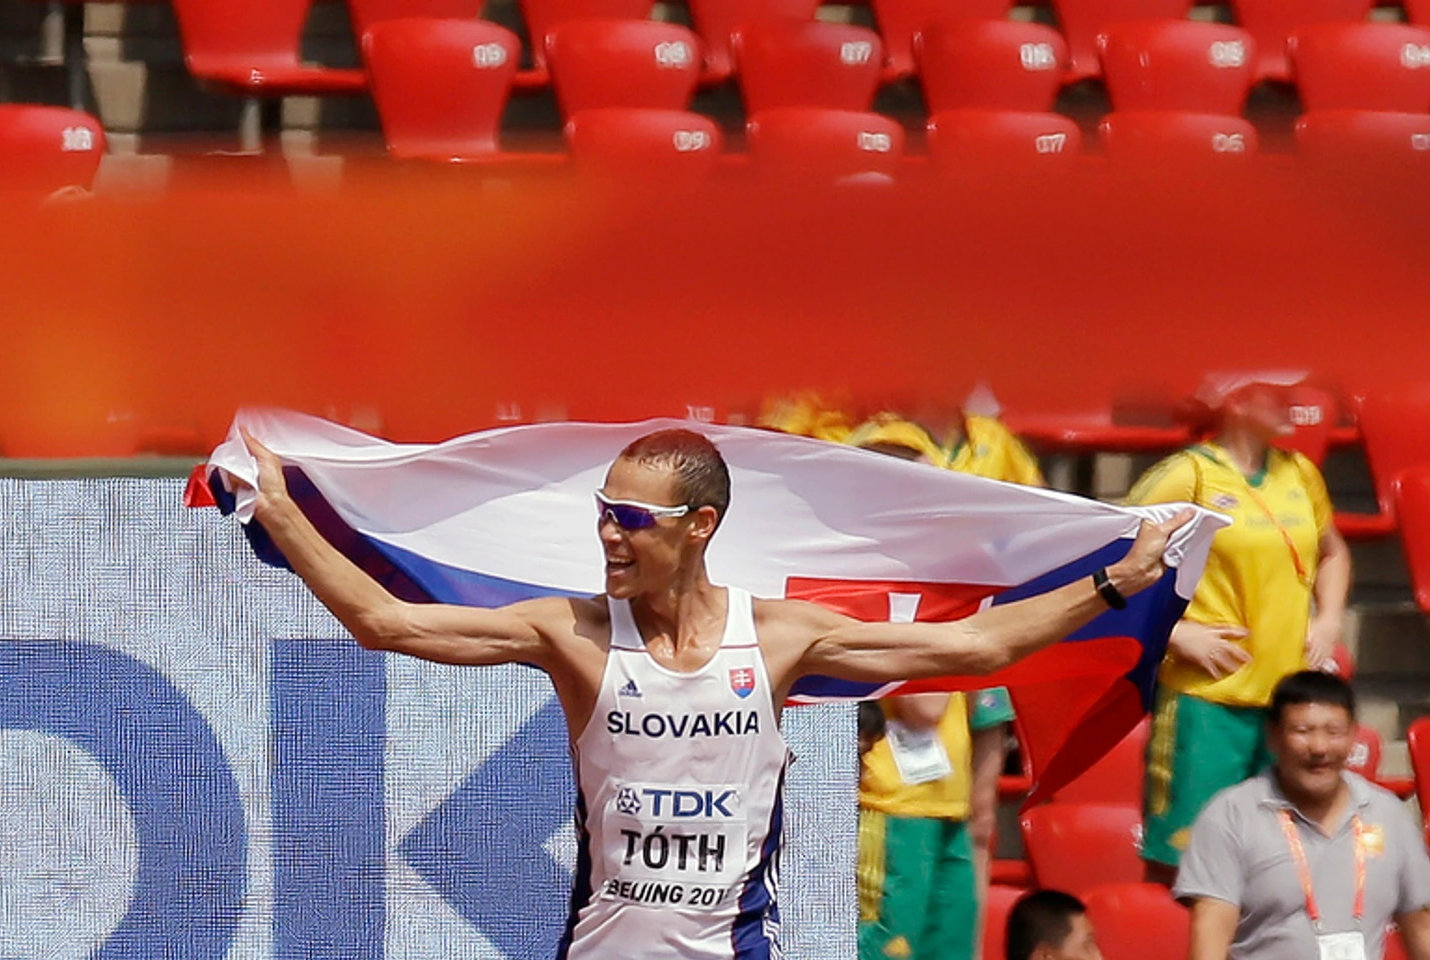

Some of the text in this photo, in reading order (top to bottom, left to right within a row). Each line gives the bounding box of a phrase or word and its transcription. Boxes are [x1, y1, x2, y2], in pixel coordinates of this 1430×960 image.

[840, 42, 870, 63] 07
[673, 130, 709, 151] 09
[1035, 134, 1065, 154] 07
[1212, 133, 1244, 152] 06
[607, 710, 760, 738] SLOVAKIA
[642, 789, 737, 818] TDK
[620, 826, 726, 873] TÓTH
[605, 879, 730, 906] BEIJING 201
